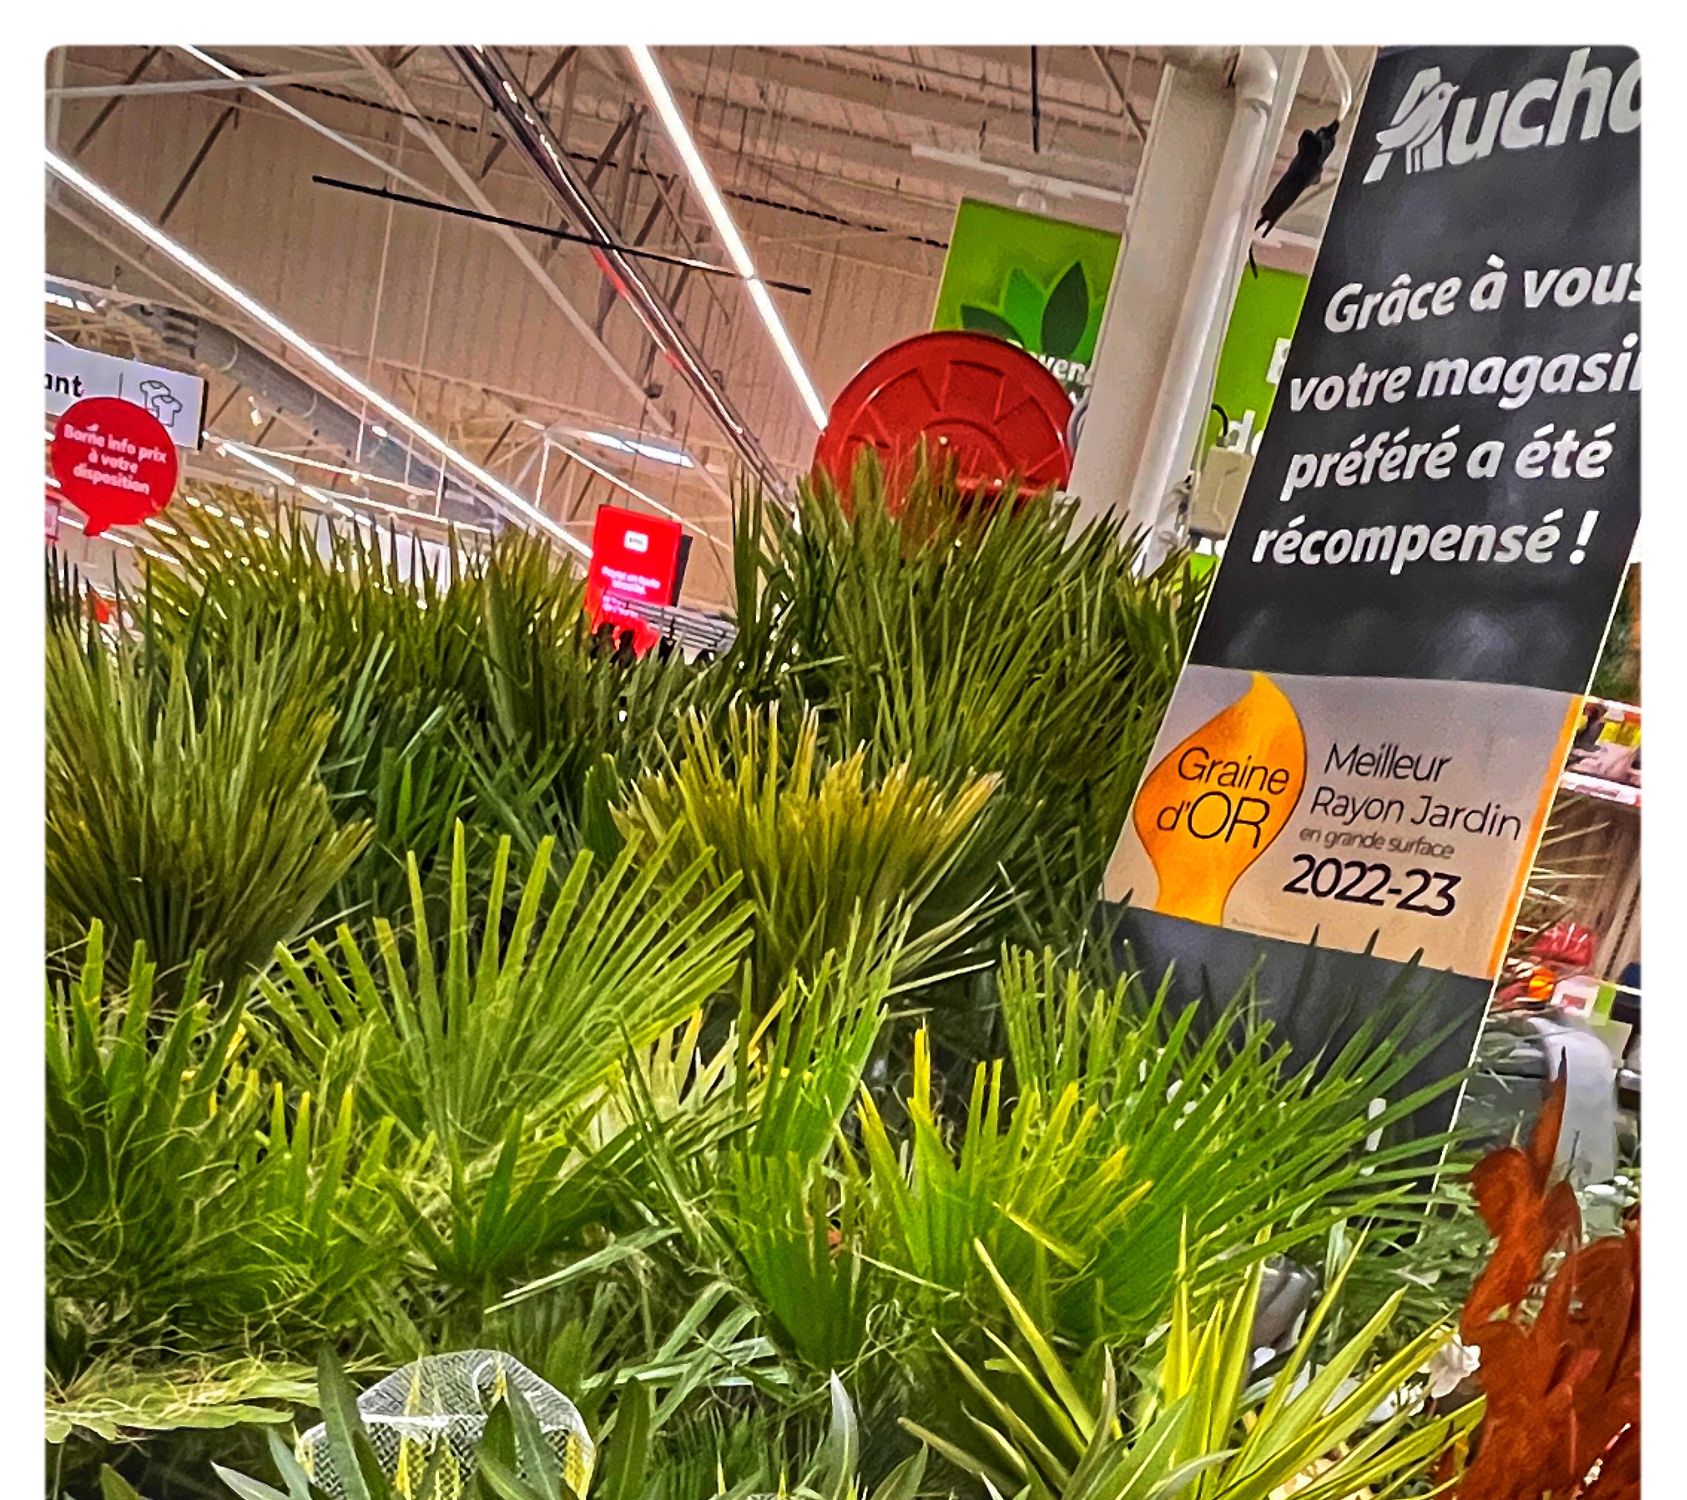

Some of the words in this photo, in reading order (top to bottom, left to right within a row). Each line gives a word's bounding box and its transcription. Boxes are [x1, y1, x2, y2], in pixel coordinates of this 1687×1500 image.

[1324, 273, 1462, 333] Grâce
[1469, 254, 1508, 312] à
[1290, 363, 1411, 412] votre
[101, 454, 139, 474] votre
[107, 434, 136, 455] info
[138, 446, 167, 463] prix
[1280, 424, 1461, 501] préféré
[1466, 440, 1505, 479] a
[1515, 423, 1616, 478] été
[73, 463, 150, 495] disposition
[1252, 508, 1563, 575] récompensé
[1177, 747, 1290, 795] Graine
[1324, 743, 1451, 782] Meilleur
[1310, 786, 1404, 826] Rayon
[1411, 795, 1522, 840] Jardin
[1299, 827, 1322, 844] en
[1325, 831, 1386, 852] grande
[1388, 836, 1455, 859] surface
[1283, 854, 1462, 917] 2022-23
